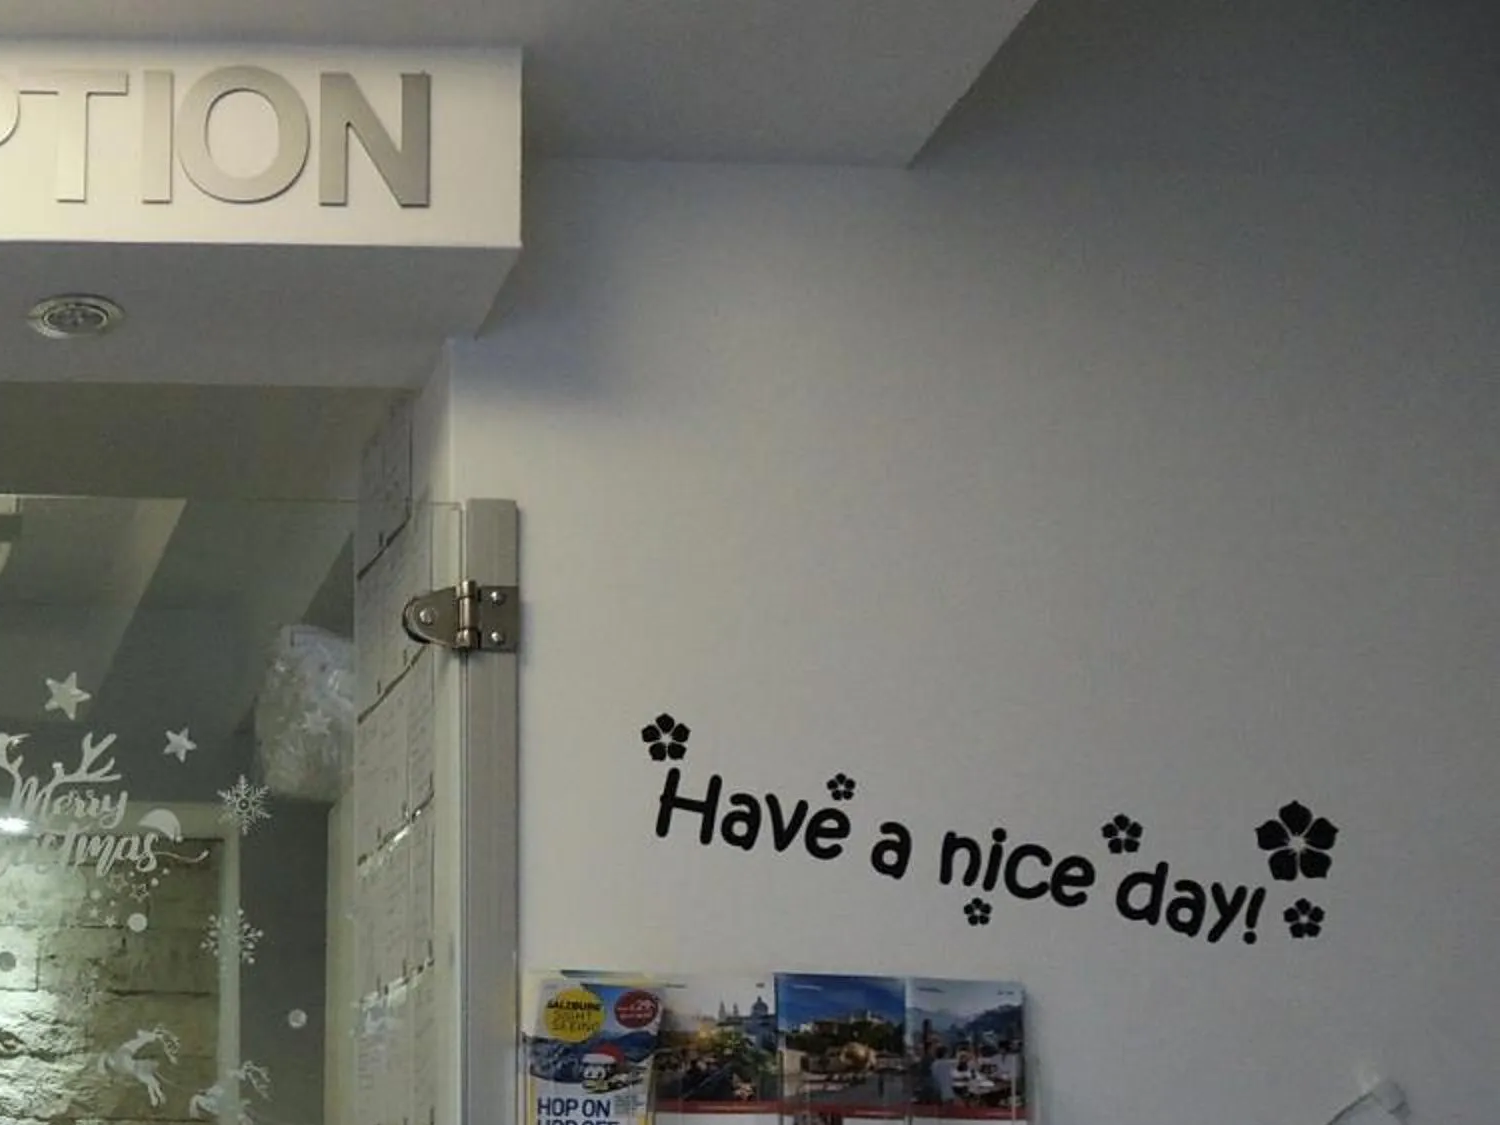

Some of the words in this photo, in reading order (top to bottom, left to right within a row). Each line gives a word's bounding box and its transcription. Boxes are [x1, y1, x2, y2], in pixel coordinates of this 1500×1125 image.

[9, 776, 130, 830] Merry
[654, 767, 852, 860] Have
[870, 821, 912, 880] a
[938, 826, 1096, 908] nice
[1115, 861, 1267, 945] day!
[536, 1097, 579, 1117] HOP
[581, 1098, 612, 1118] ON
